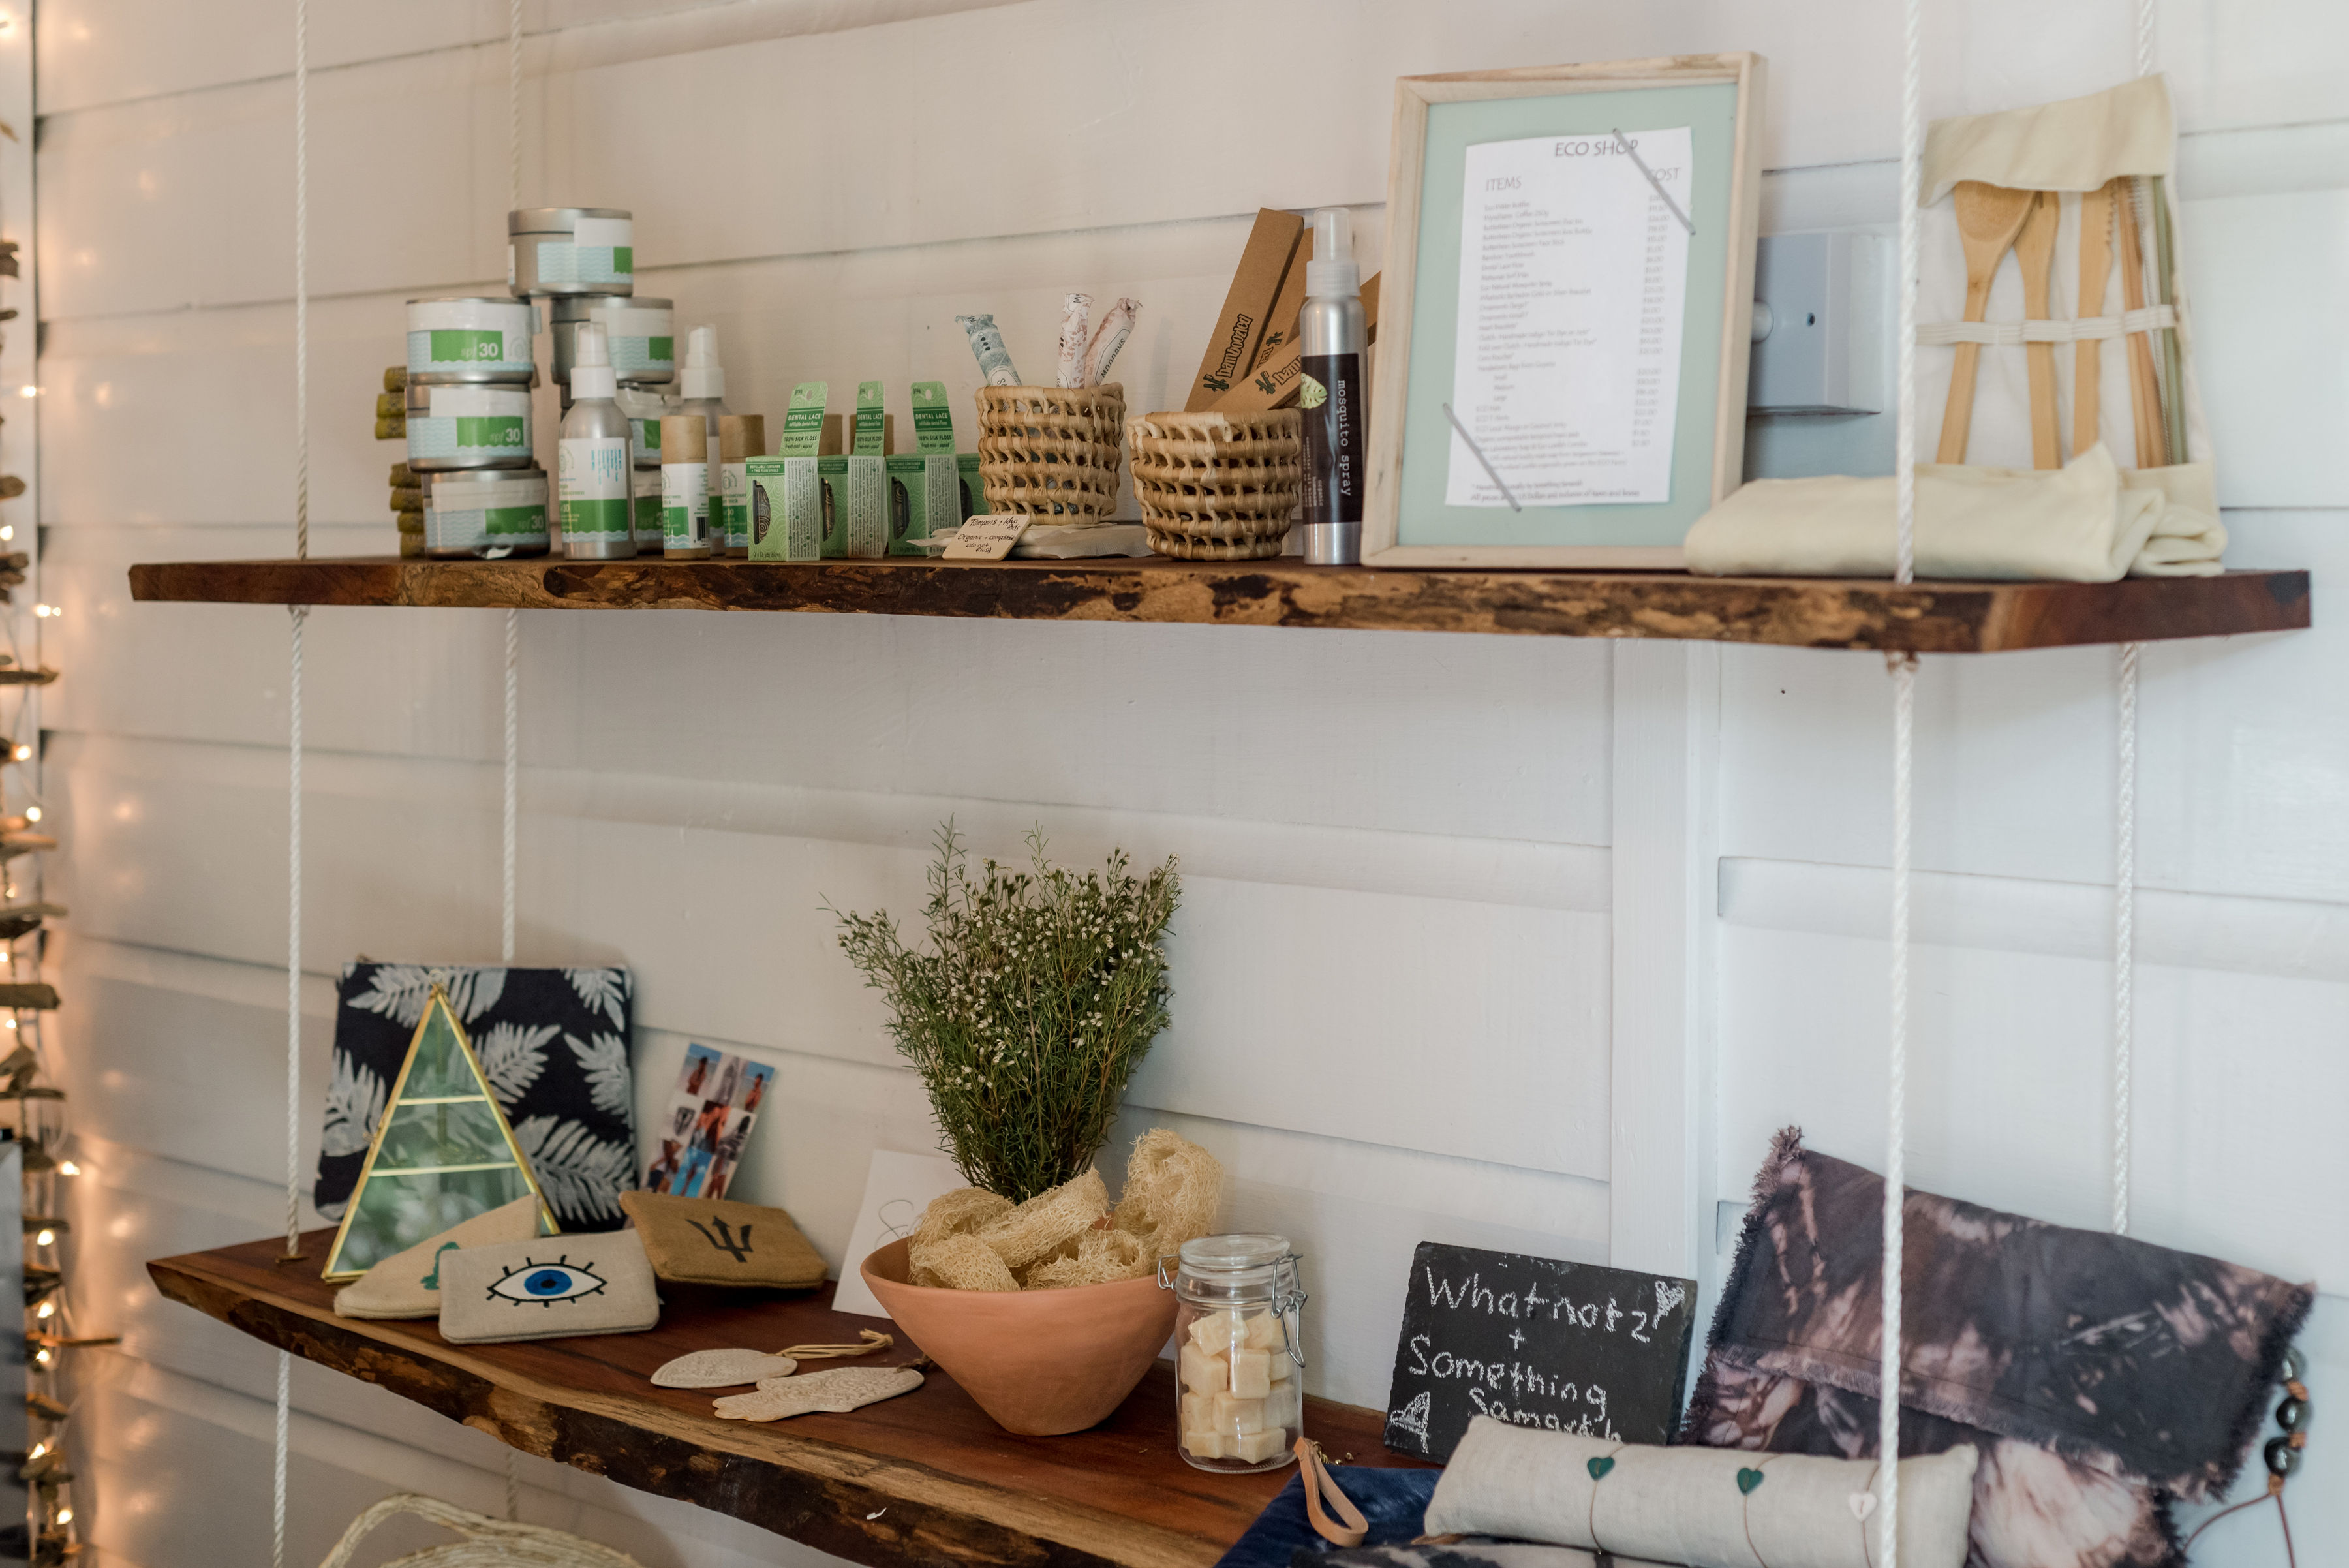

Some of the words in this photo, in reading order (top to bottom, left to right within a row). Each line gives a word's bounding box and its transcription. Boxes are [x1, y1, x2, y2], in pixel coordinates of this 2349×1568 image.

[1555, 142, 1589, 157] ECO
[1486, 176, 1522, 191] ITEMS
[1648, 167, 1681, 182] OST
[478, 343, 499, 358] 30
[1336, 380, 1350, 447] mosquito
[506, 428, 521, 442] 30
[1339, 455, 1351, 496] spray
[957, 533, 982, 542] Organic
[1407, 1333, 1607, 1422] Something
